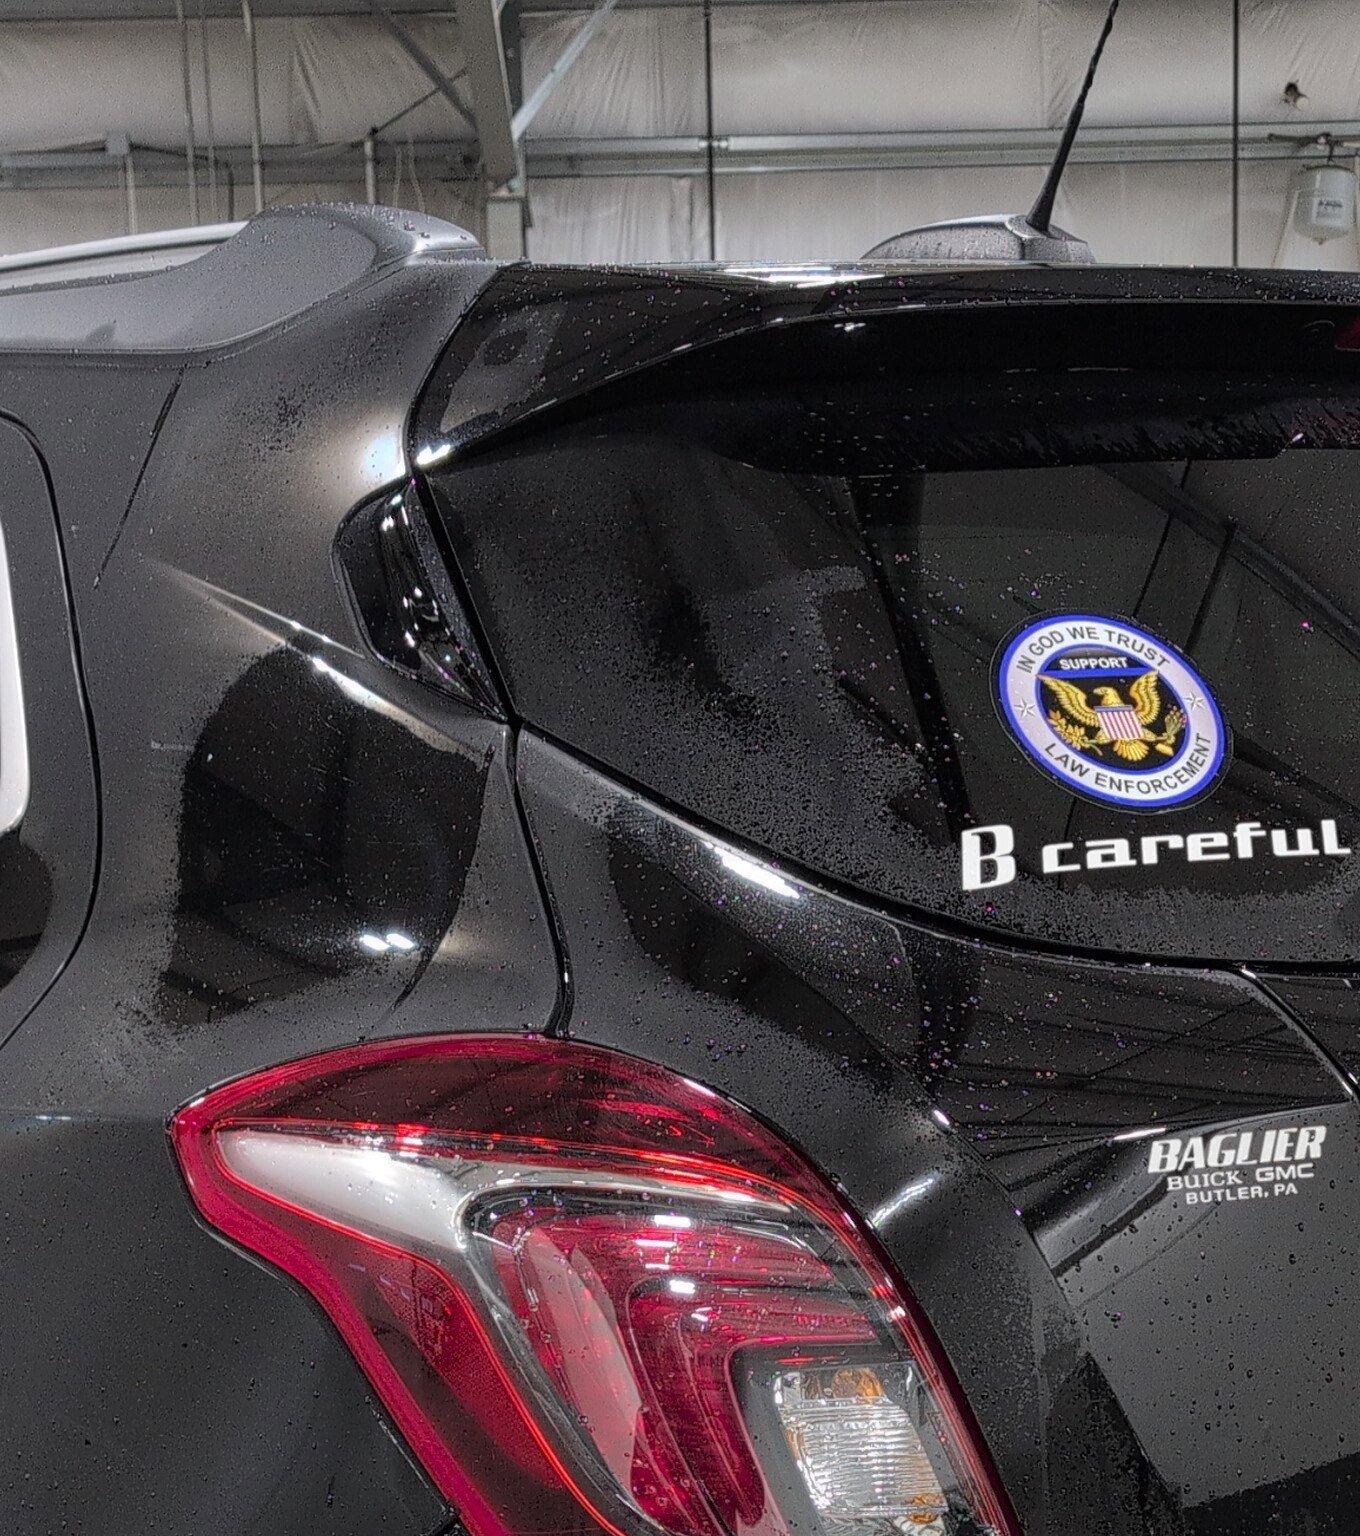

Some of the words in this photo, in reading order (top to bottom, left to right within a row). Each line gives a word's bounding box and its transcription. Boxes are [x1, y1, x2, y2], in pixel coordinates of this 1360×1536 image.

[1016, 654, 1037, 674] IN
[1028, 630, 1065, 658] GOD
[1066, 625, 1100, 642] WE
[1104, 628, 1171, 670] TRUST
[1058, 655, 1129, 671] SUPPORT
[1044, 741, 1090, 779] LAW
[1094, 732, 1212, 795] ENFORCEMENT
[960, 824, 1017, 892] B
[1041, 818, 1351, 874] careful
[1147, 1125, 1327, 1174] BAGLIER
[1166, 1170, 1243, 1191] BUICK
[1255, 1162, 1315, 1182] GMC
[1185, 1185, 1269, 1205] BUTLER,
[1273, 1183, 1298, 1196] PA
